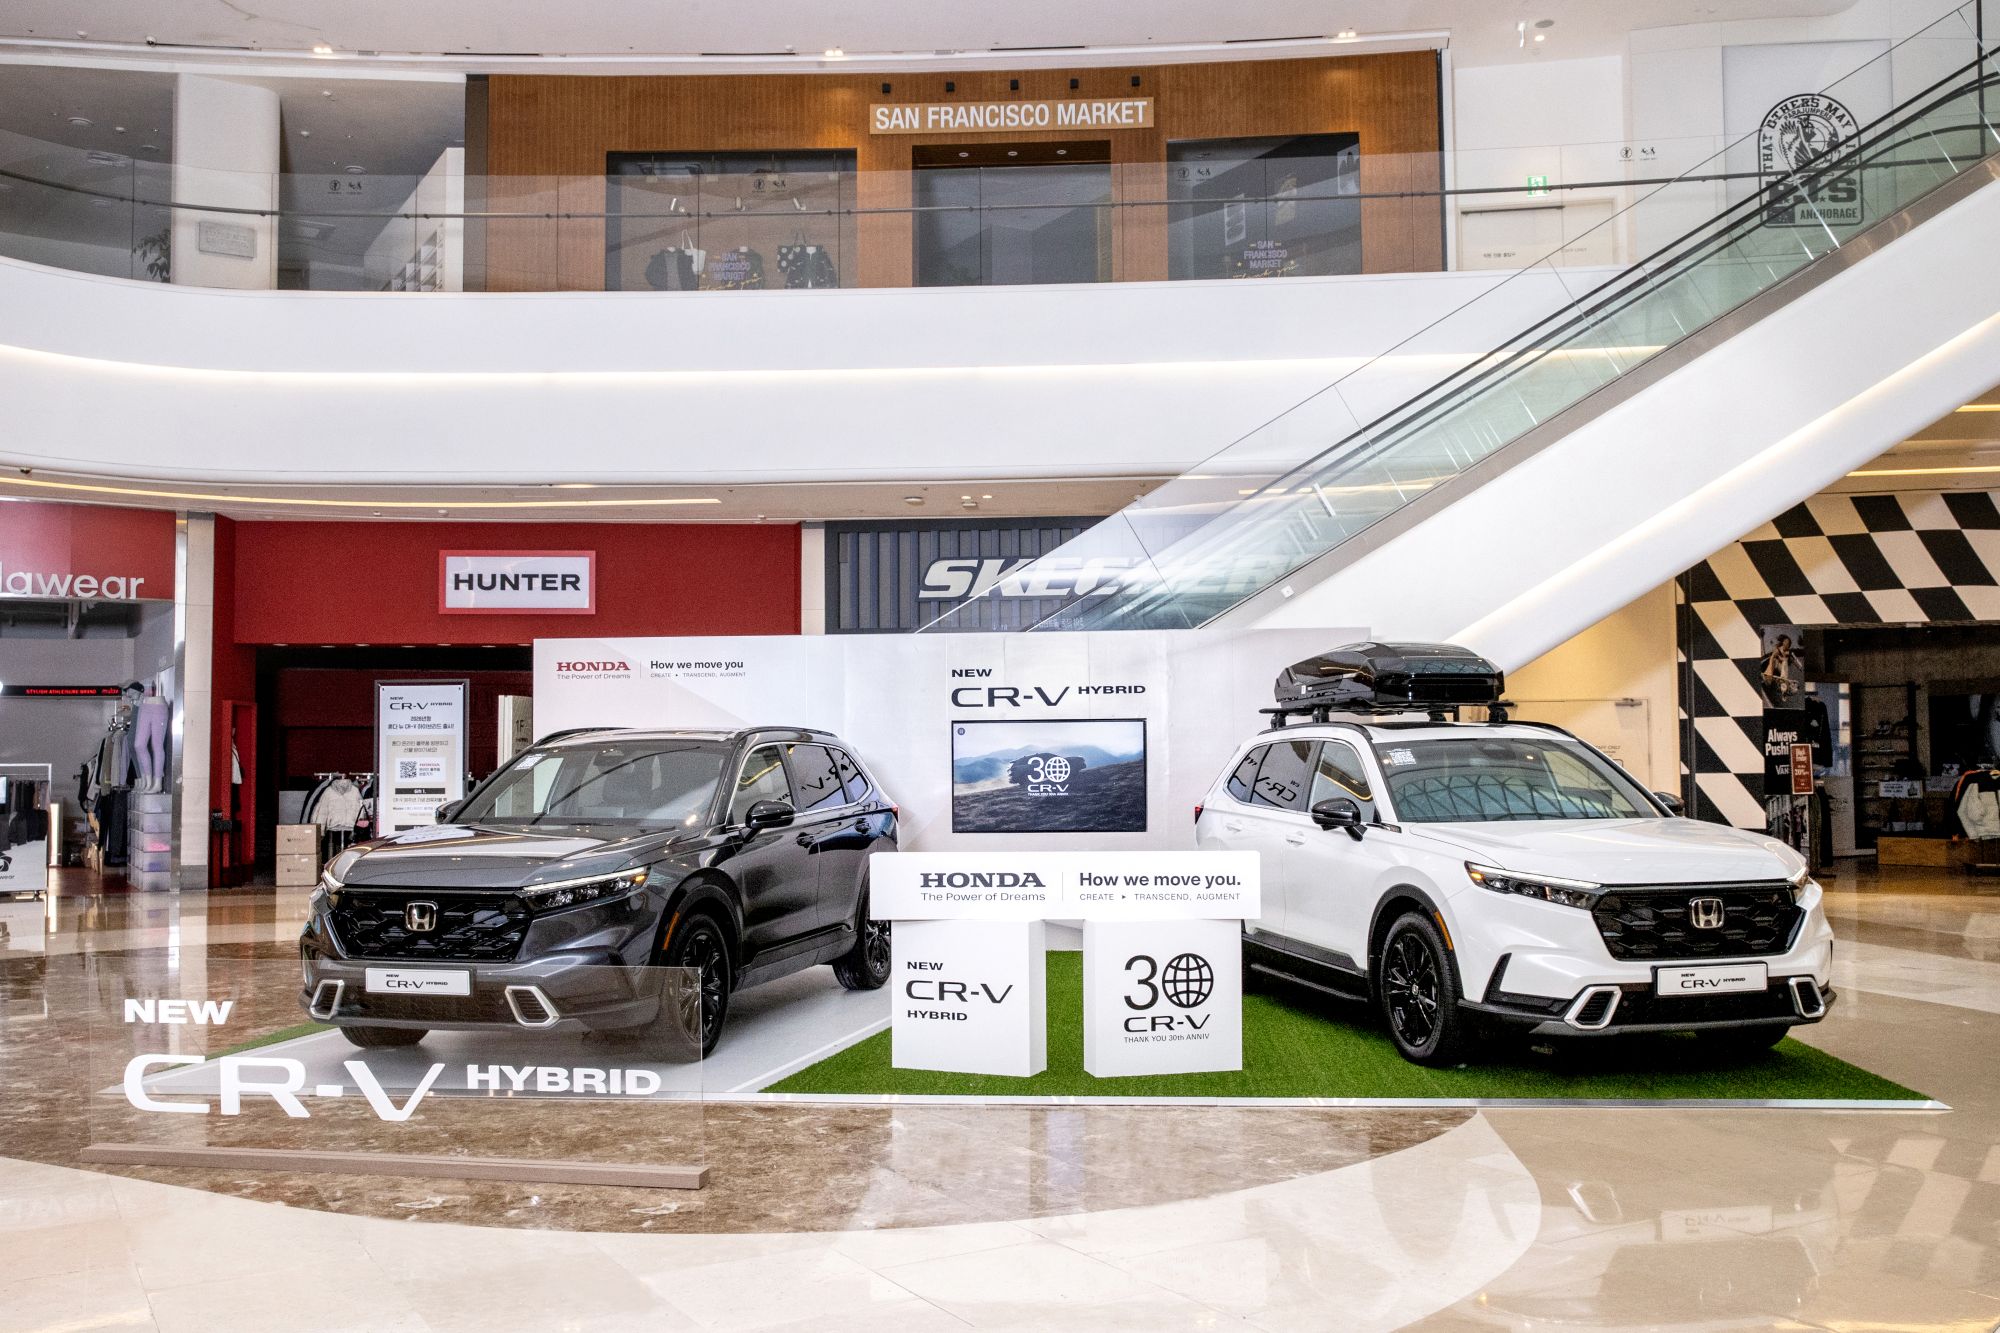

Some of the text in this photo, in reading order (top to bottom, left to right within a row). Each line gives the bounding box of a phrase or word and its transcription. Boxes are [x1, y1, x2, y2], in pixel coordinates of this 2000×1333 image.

[875, 101, 1147, 130] SAN FRANCISCO MARKET
[1765, 98, 1820, 130] OTHERS
[1824, 102, 1853, 129] MAY
[1784, 107, 1833, 121] PARAJUMPERS
[1800, 208, 1858, 220] ANCHORAGE
[1257, 240, 1274, 249] SAN
[1244, 250, 1288, 259] FRANCISCO
[1250, 259, 1282, 268] MARKET
[453, 573, 581, 591] HUNTER
[556, 661, 631, 672] HONDA
[650, 661, 674, 669] How
[725, 661, 744, 671] you
[951, 669, 993, 678] NEW
[951, 685, 1146, 708] CR-V HYBRID
[389, 702, 428, 710] CR-V
[1767, 728, 1798, 743] Always
[1027, 784, 1069, 792] CR-V
[920, 872, 1046, 888] HONDA
[1079, 872, 1241, 890] How we move you.
[920, 892, 1046, 901] The Power of Dreams
[1079, 893, 1115, 901] CREATE
[1196, 893, 1241, 901] AUGMENT
[907, 961, 943, 970] NEW
[386, 979, 424, 988] CR-V
[1681, 978, 1721, 989] CR-V
[905, 980, 1013, 1004] CR-V
[123, 998, 233, 1025] NEW
[907, 1010, 968, 1021] HYBRID
[1123, 1014, 1211, 1032] CR-V
[1124, 1036, 1150, 1044] THANK
[123, 1053, 662, 1121] CR-V HYBRID
